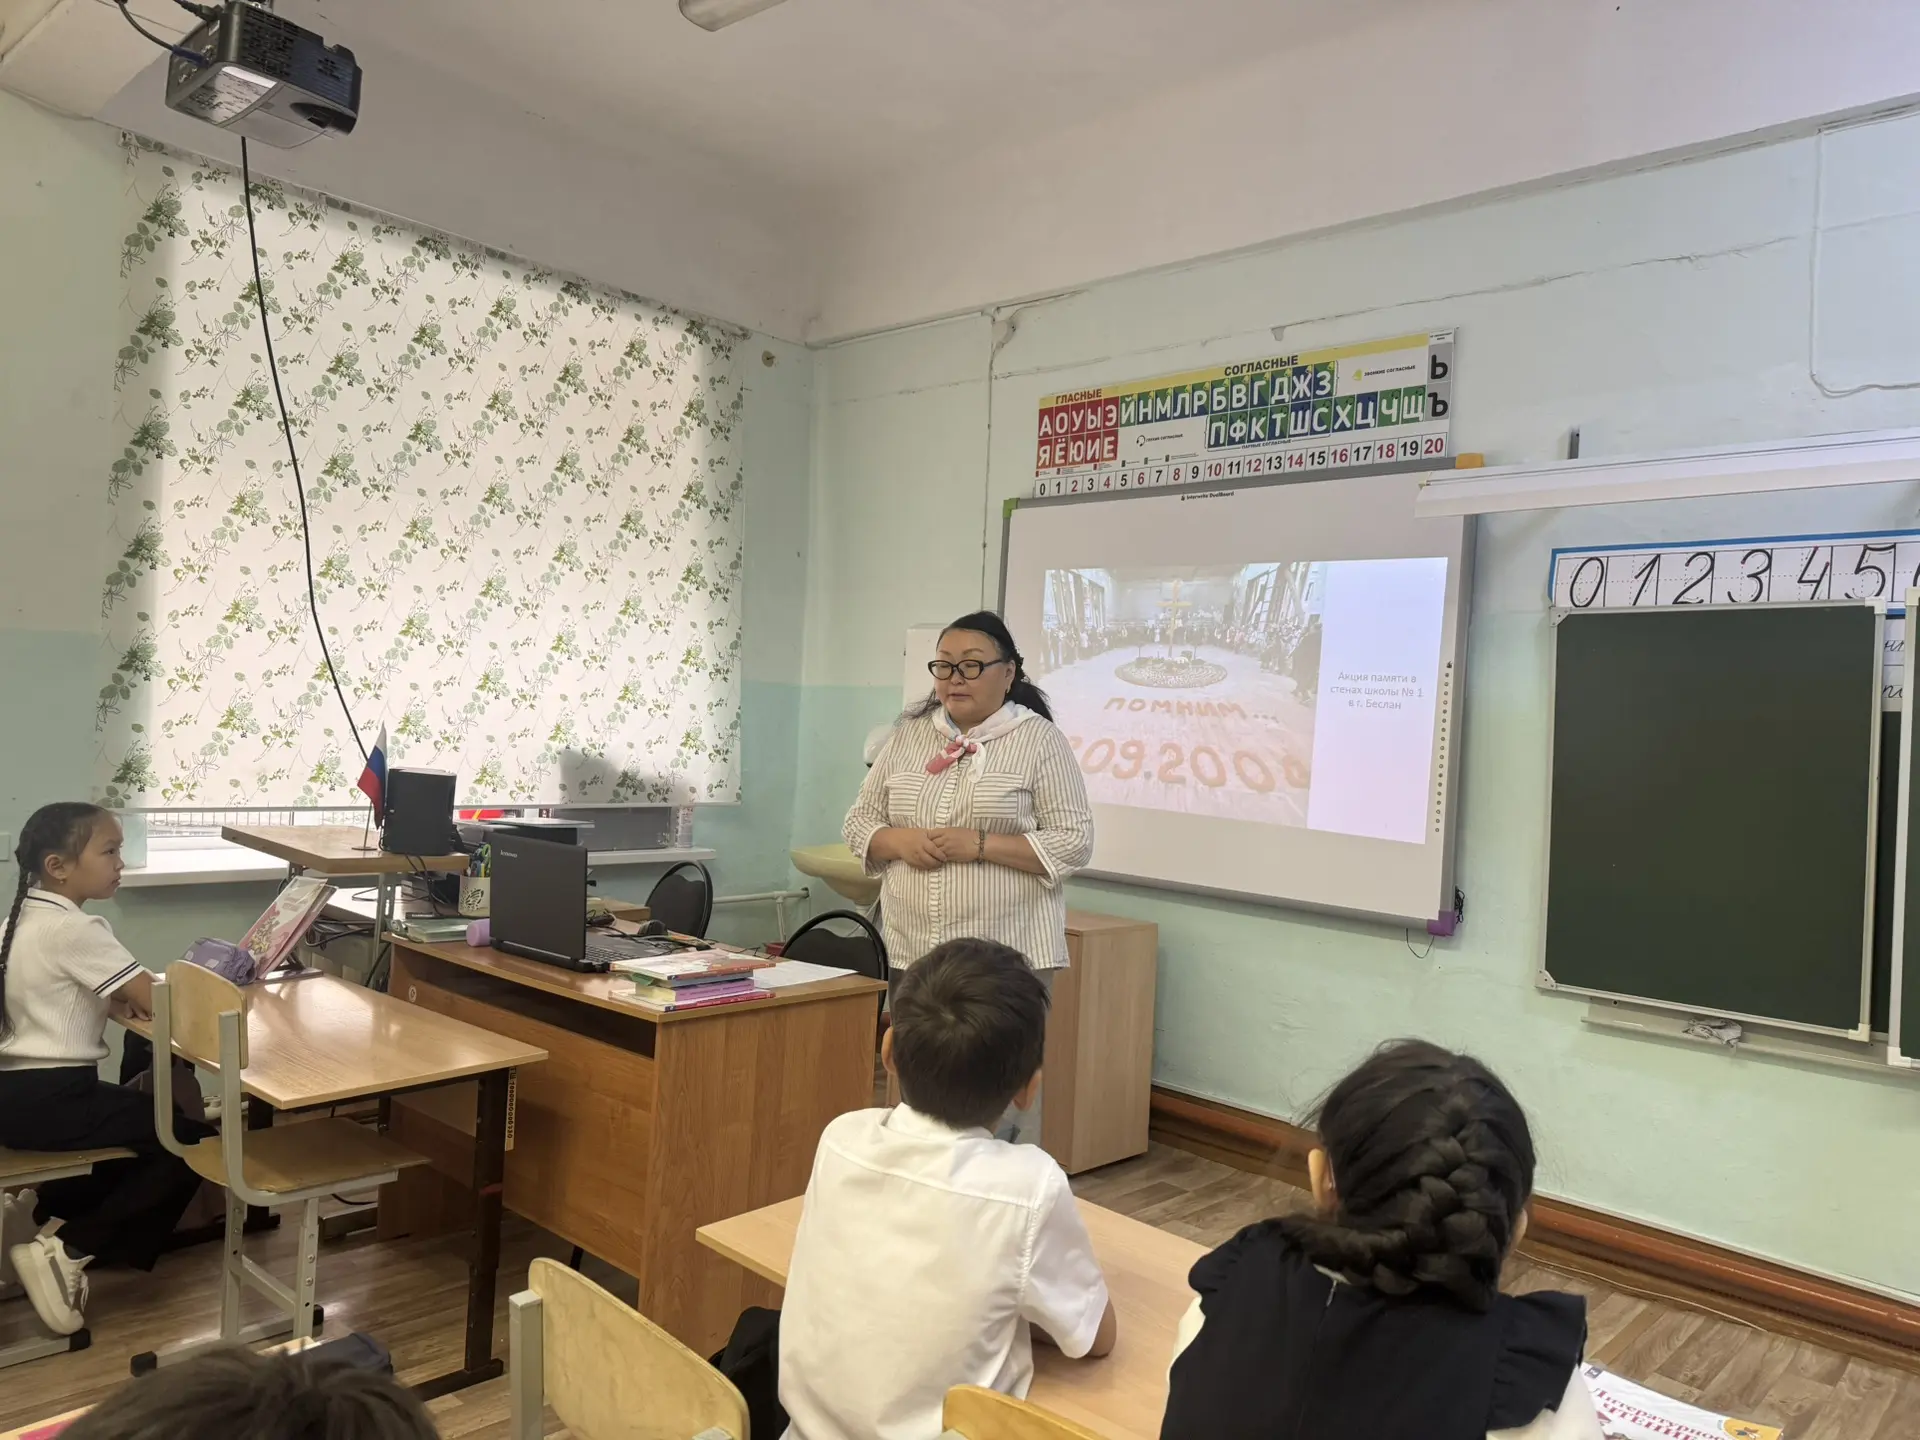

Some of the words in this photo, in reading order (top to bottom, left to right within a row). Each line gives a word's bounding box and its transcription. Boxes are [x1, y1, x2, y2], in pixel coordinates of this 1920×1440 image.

[1224, 355, 1299, 377] СОГЛАСНЫЕ
[1386, 364, 1416, 373] СОГЛАСНЫЕ
[1055, 388, 1102, 405] ГЛАСНЫЕ
[1040, 483, 1046, 496] 0
[1056, 482, 1061, 494] 1
[1071, 480, 1078, 493] 2
[1087, 478, 1094, 491] 3
[1103, 476, 1110, 489] 4
[1120, 474, 1128, 487] 5
[1138, 472, 1145, 485] 6
[1155, 470, 1163, 483] 7
[1173, 468, 1181, 481] 8
[1192, 466, 1199, 479] 9
[1207, 463, 1222, 477] 10
[1227, 460, 1241, 475] 11
[1246, 458, 1261, 473] 12
[1266, 456, 1282, 471] 13
[1287, 453, 1304, 468] 14
[1308, 451, 1326, 466] 15
[1331, 448, 1348, 464] 16
[1353, 446, 1372, 461] 17
[1377, 444, 1395, 459] 18
[1400, 440, 1419, 457] 19
[1424, 438, 1444, 455] 20
[1569, 556, 1604, 608] 0
[1632, 553, 1660, 606] 1
[1672, 551, 1715, 605] 2
[1727, 548, 1772, 603] 3
[1797, 545, 1830, 600] 4
[1844, 543, 1896, 599] 5
[1338, 671, 1368, 682] Акция
[1371, 673, 1408, 683] памяти
[1410, 675, 1417, 683] в
[1330, 686, 1362, 695] стенах
[1364, 687, 1399, 696] школы
[1402, 688, 1414, 697] №
[1416, 688, 1424, 697] 1
[1366, 699, 1401, 710] Беслан
